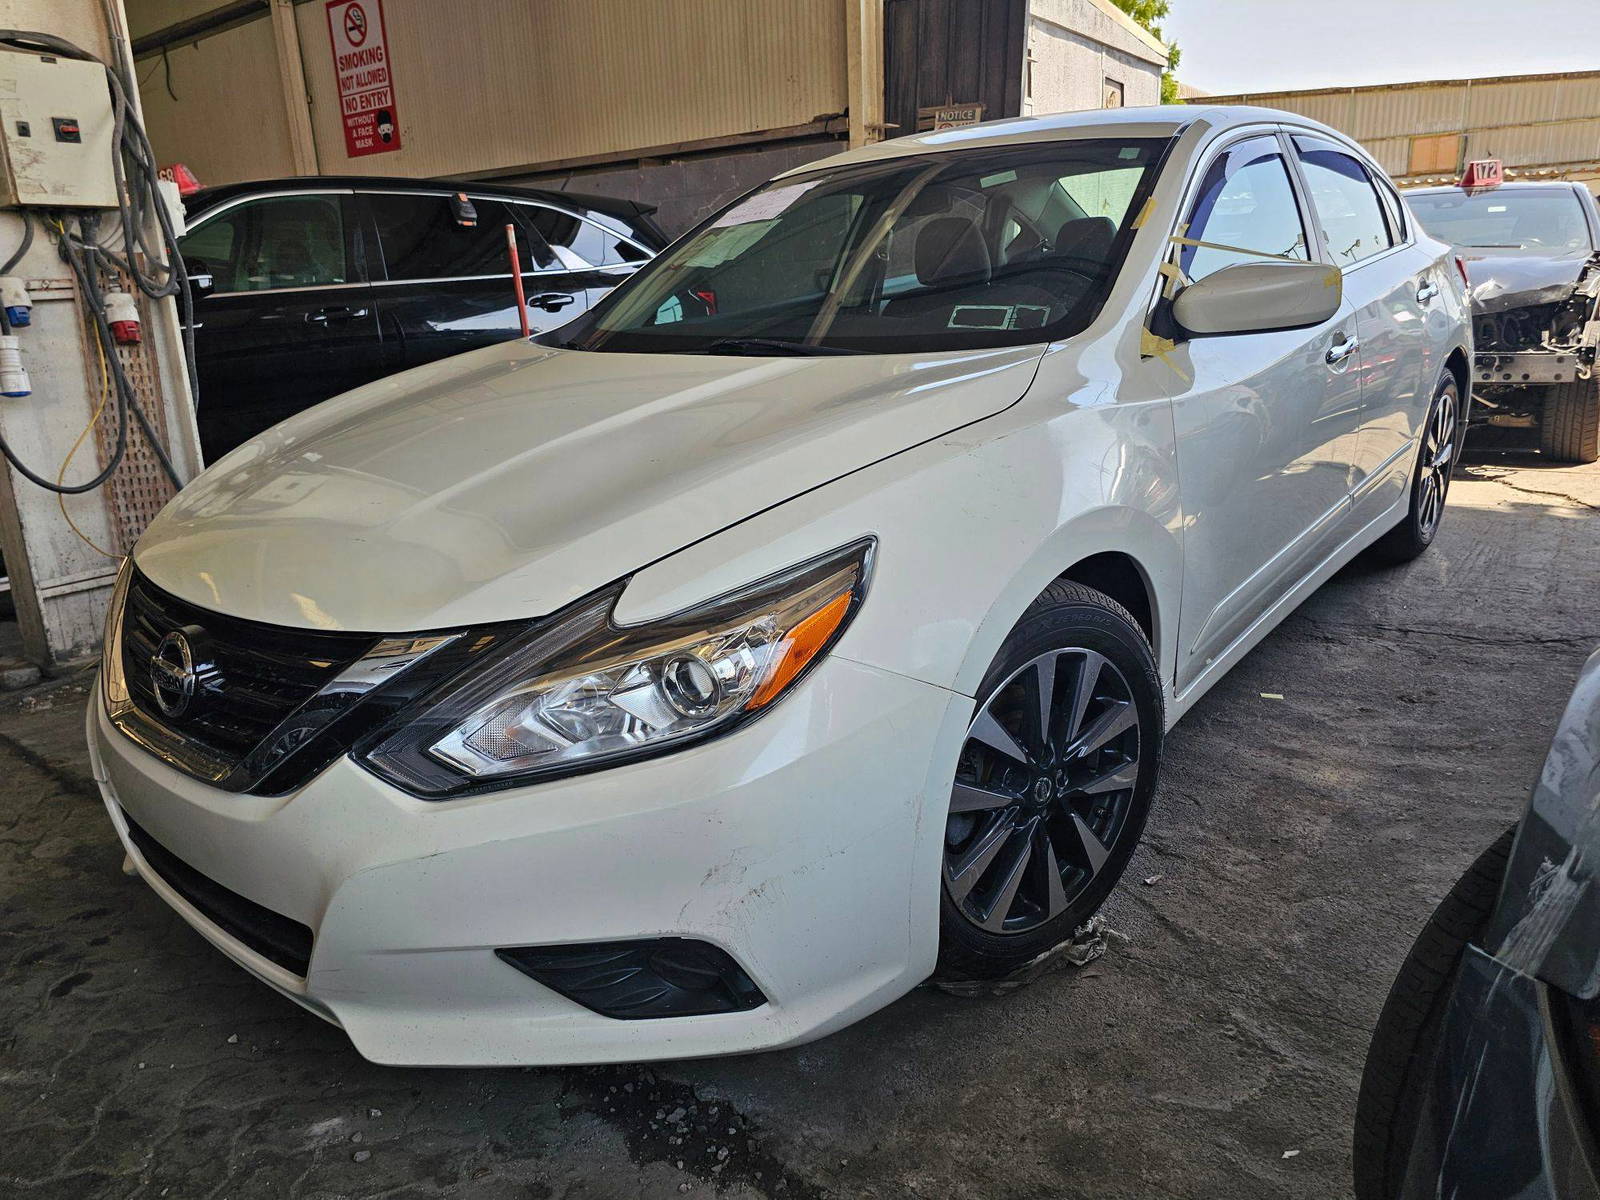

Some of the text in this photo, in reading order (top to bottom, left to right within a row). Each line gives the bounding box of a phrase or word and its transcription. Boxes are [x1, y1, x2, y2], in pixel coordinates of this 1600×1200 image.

[339, 46, 383, 72] SMOKING
[341, 67, 387, 92] NOT ALLOWED
[345, 90, 388, 113] NO ENTRY
[347, 114, 375, 128] WITHOUT
[940, 110, 973, 120] NOTICE
[352, 126, 374, 138] A FACE
[355, 138, 374, 149] MASK
[1475, 162, 1497, 179] 172
